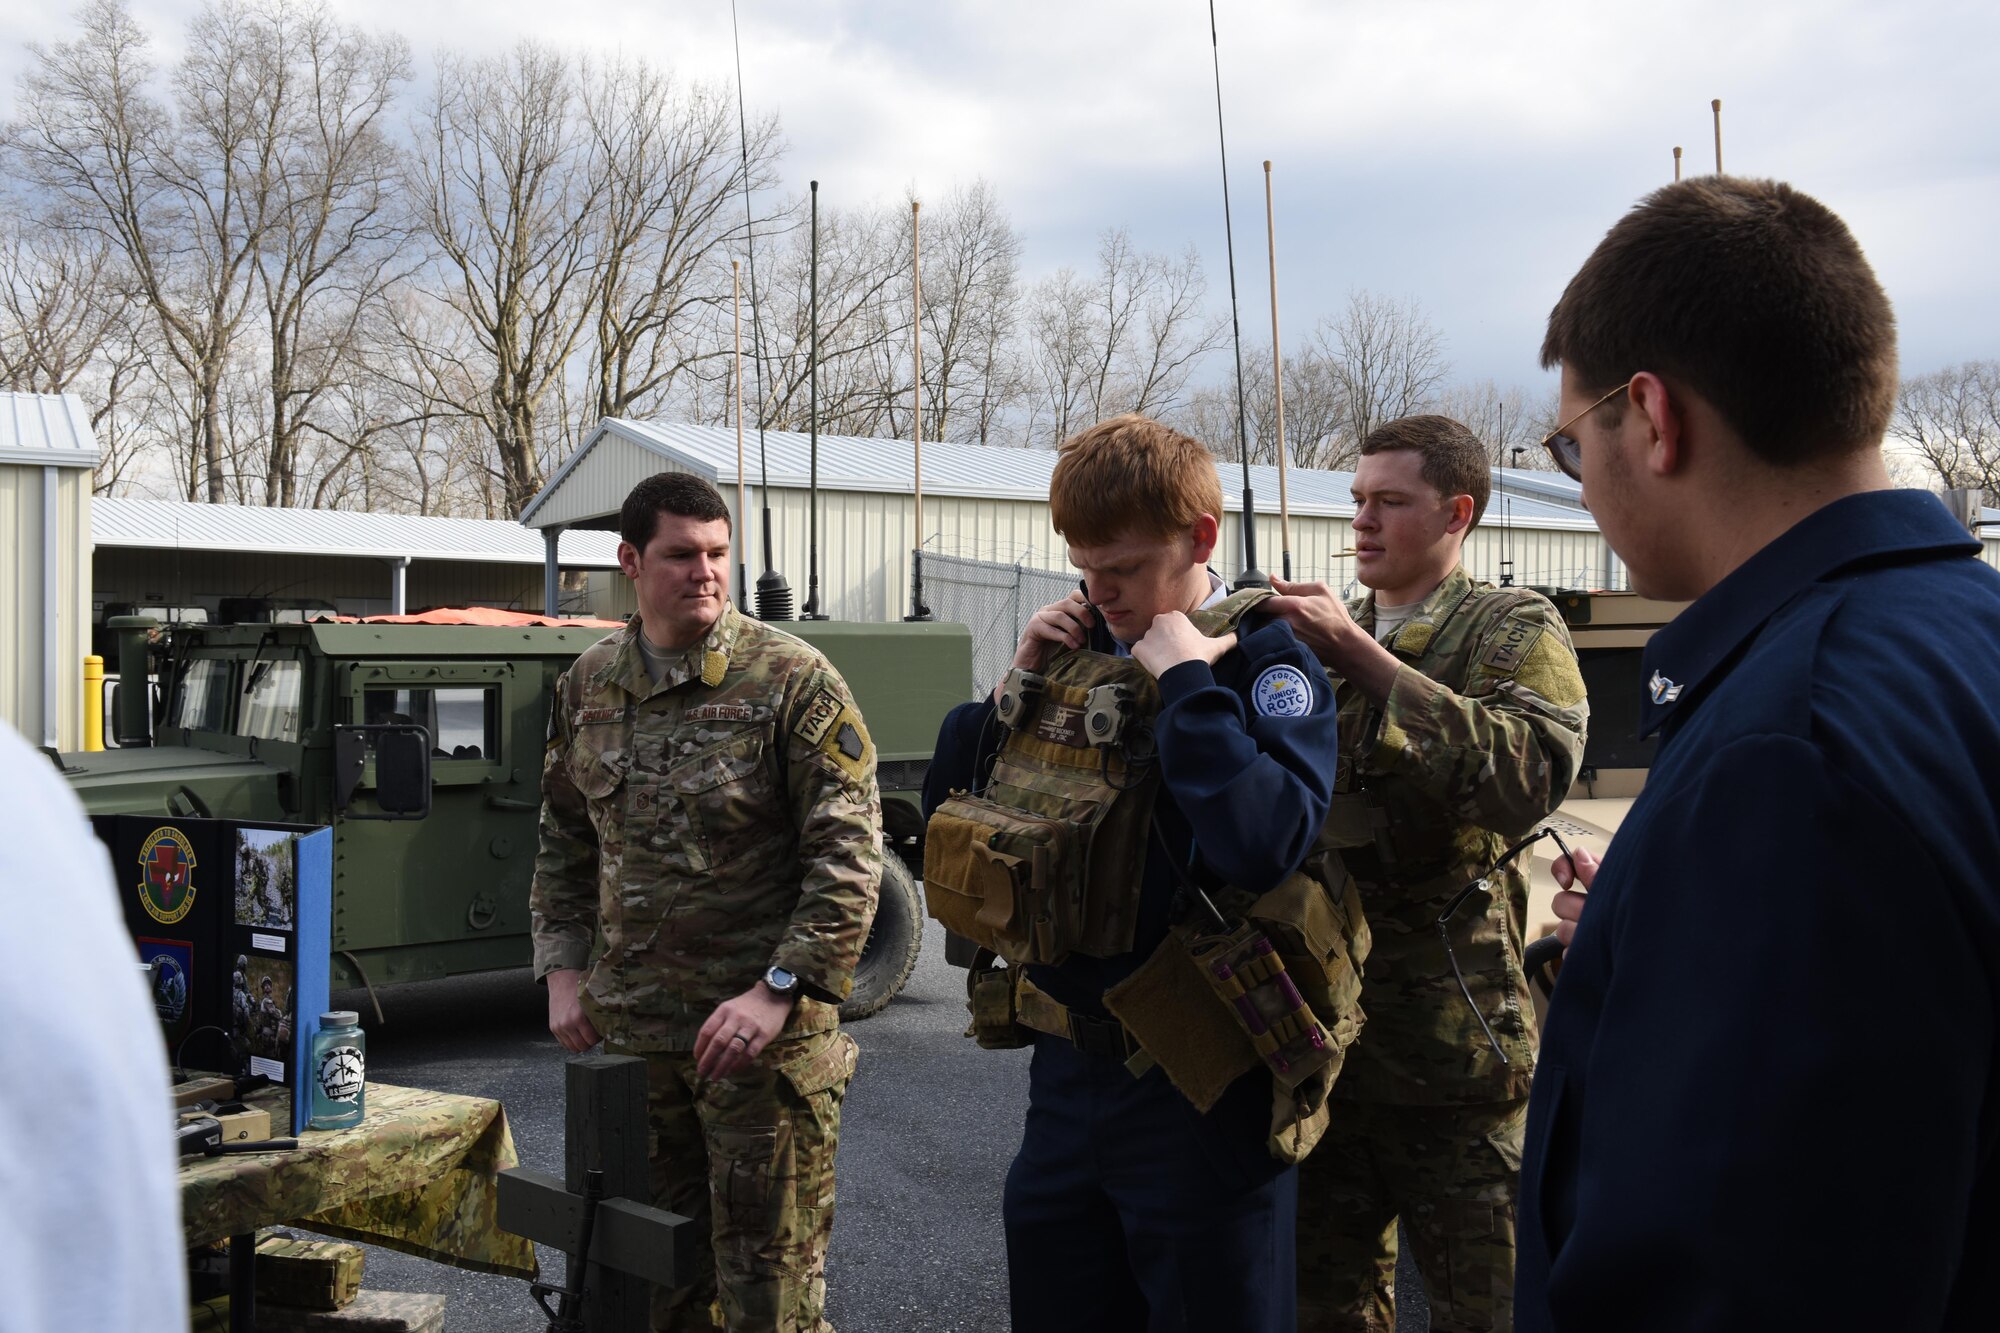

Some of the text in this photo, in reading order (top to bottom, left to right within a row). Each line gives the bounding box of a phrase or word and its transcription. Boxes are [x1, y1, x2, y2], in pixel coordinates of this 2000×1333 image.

[1490, 621, 1528, 663] TACP
[1260, 672, 1300, 695] AIR FORCE
[1267, 688, 1297, 702] JUNIOR
[1267, 694, 1304, 713] ROTC
[702, 707, 717, 719] AIR
[718, 706, 750, 720] FORCE
[800, 694, 832, 737] TACP
